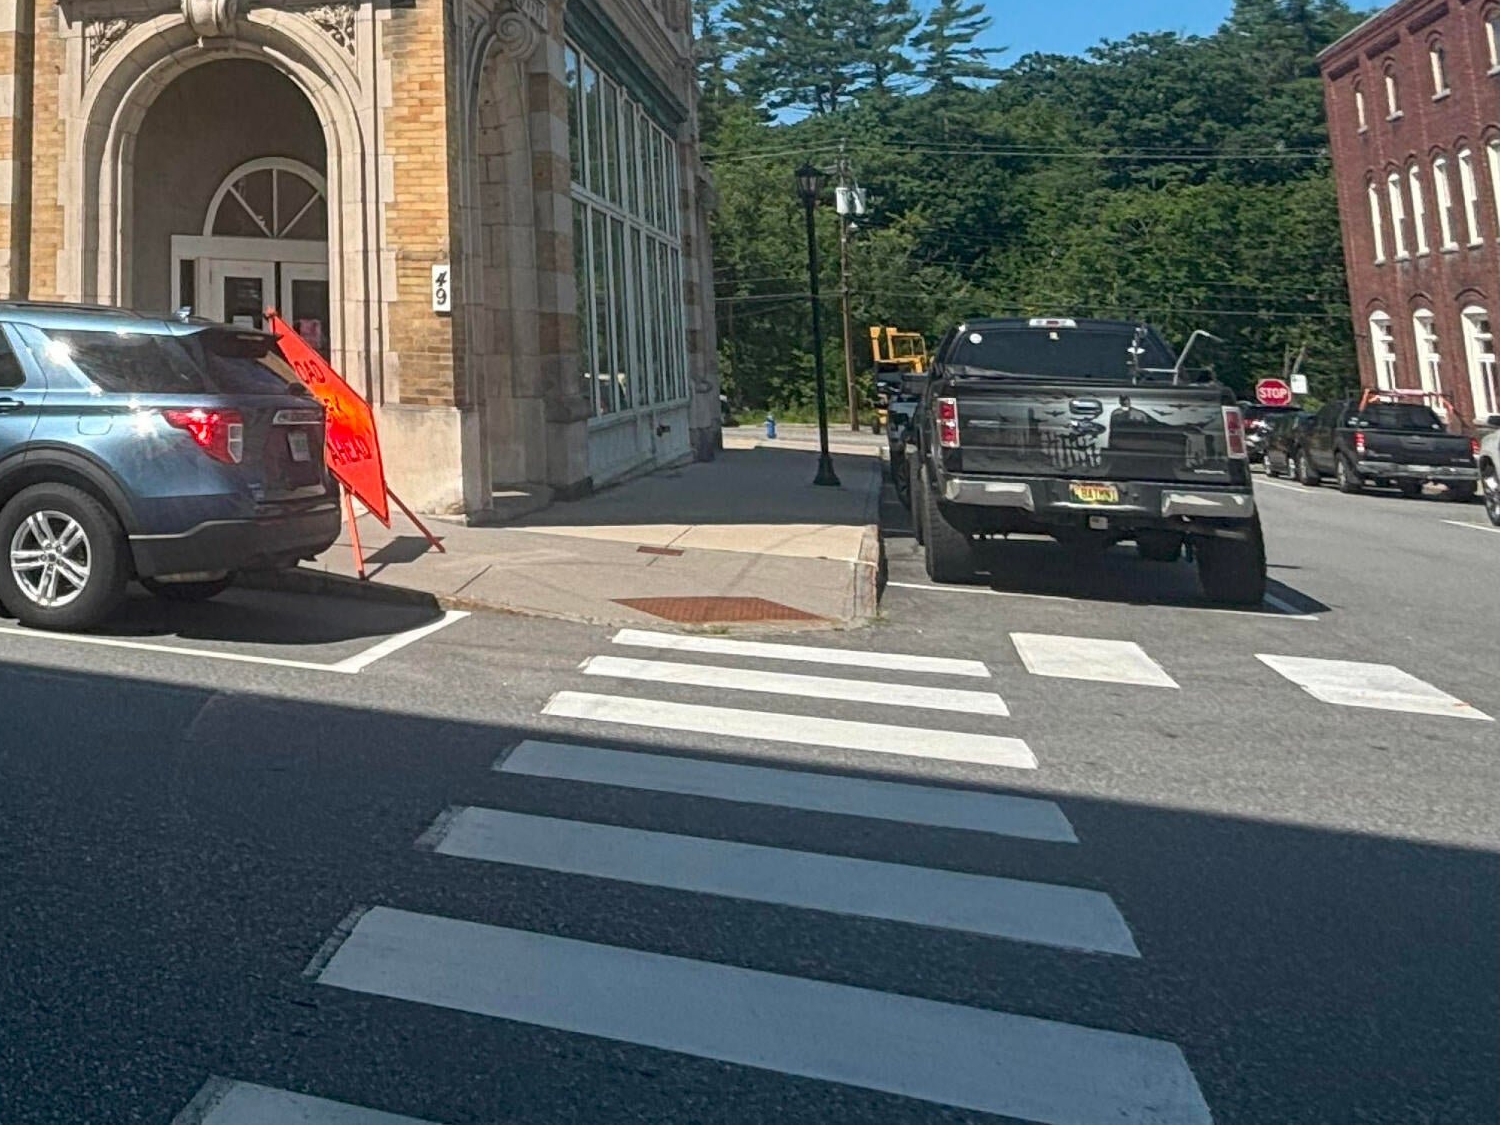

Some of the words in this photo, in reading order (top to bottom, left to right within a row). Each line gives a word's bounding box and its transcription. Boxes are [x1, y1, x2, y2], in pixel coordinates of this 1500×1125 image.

[293, 359, 326, 385] OAD
[1259, 386, 1288, 399] STOP
[327, 435, 373, 467] AHEAD
